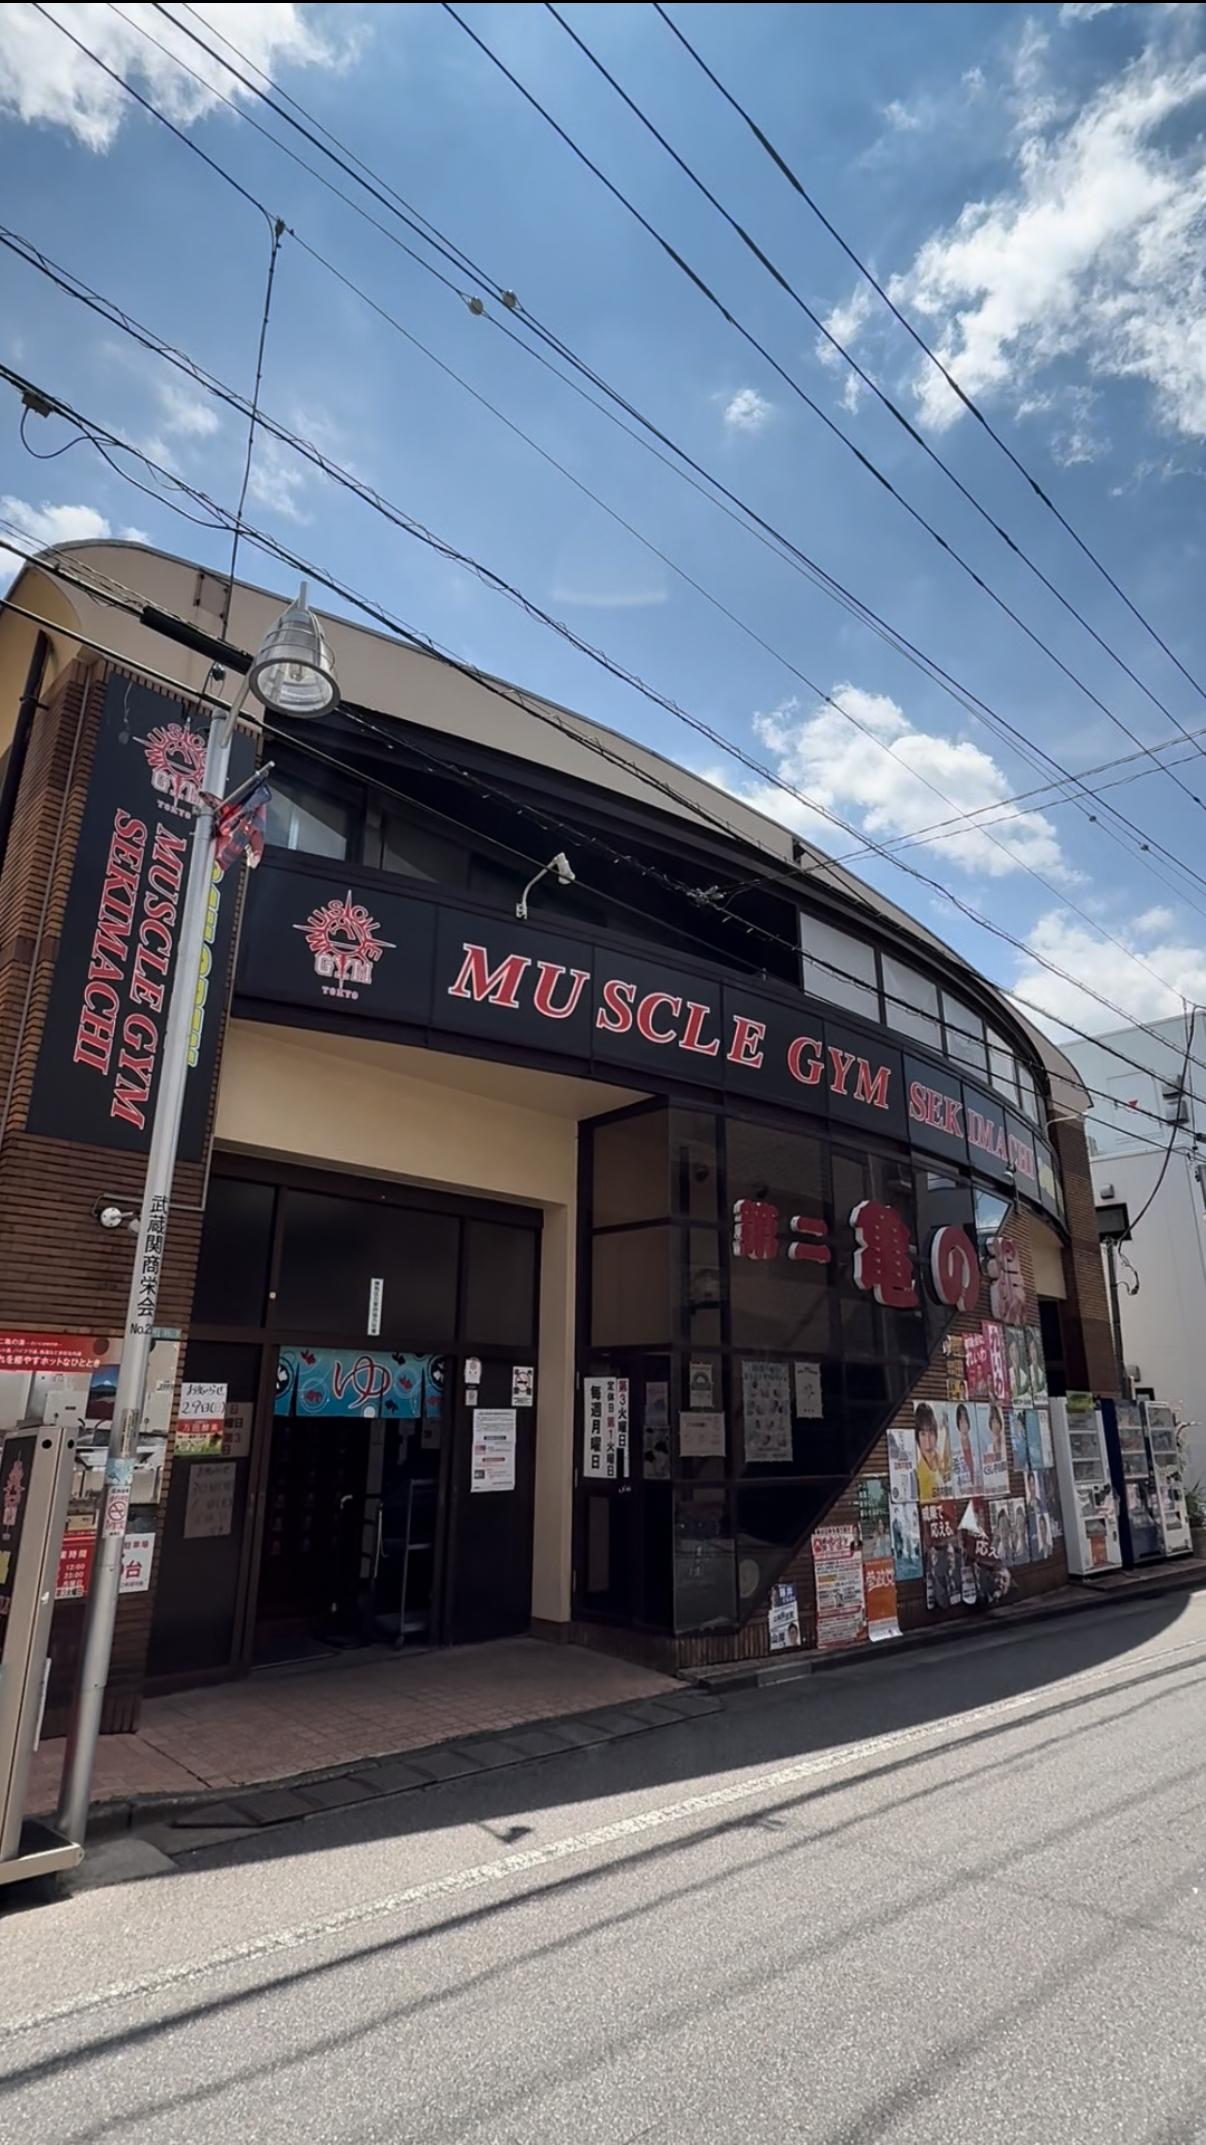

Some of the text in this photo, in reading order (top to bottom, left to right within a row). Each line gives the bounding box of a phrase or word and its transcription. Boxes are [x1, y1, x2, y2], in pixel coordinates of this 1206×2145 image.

[73, 808, 148, 1075] SEKIMACHI
[110, 822, 187, 1130] MUSCLE GYM
[314, 953, 374, 985] GYM
[321, 985, 360, 1000] TOKYO
[448, 942, 766, 1069] MUSCLE
[787, 1036, 892, 1110] GYM
[908, 1081, 1037, 1181] SEKIMACHI
[137, 1194, 169, 1317] 武蔵関商栄会
[333, 1354, 393, 1409] ゆ
[618, 1380, 628, 1447] 第3火曜日
[590, 1385, 601, 1469] 毎週月曜日
